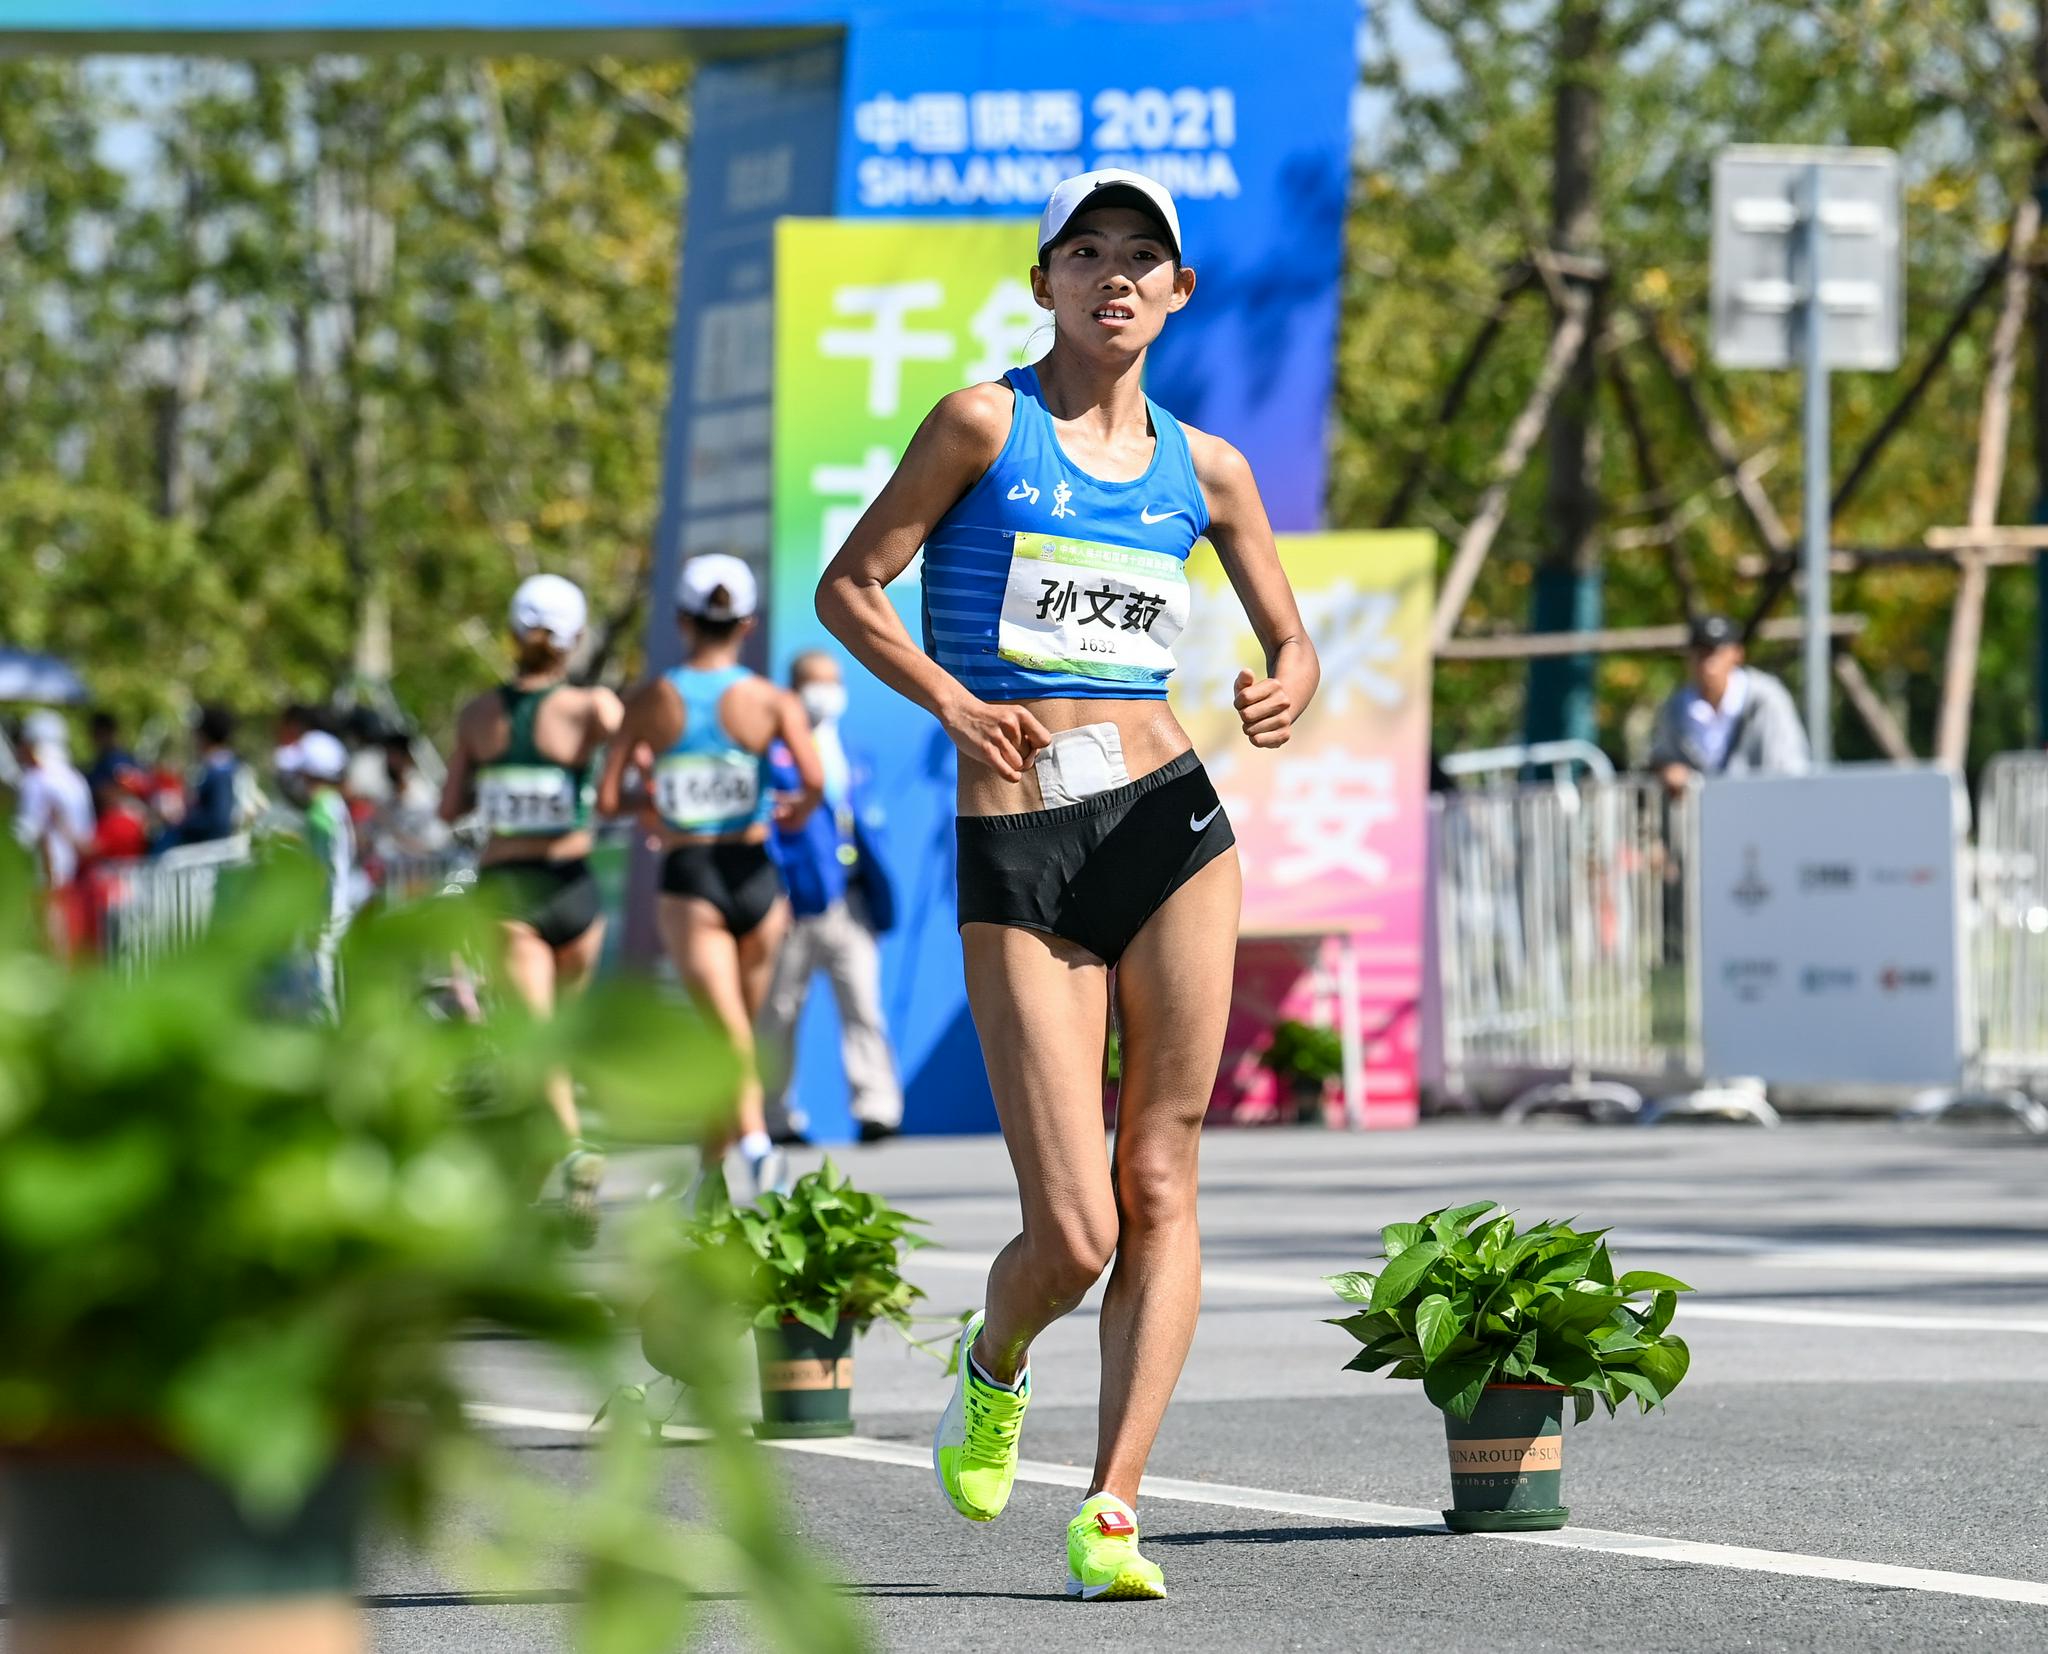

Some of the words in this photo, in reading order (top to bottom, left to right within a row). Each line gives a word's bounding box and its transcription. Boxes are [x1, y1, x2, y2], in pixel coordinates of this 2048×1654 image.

[1091, 86, 1238, 150] 2021
[1036, 579, 1167, 633] 孙文茹
[1080, 637, 1117, 654] 1632
[1449, 1448, 1525, 1463] SUNAROUD
